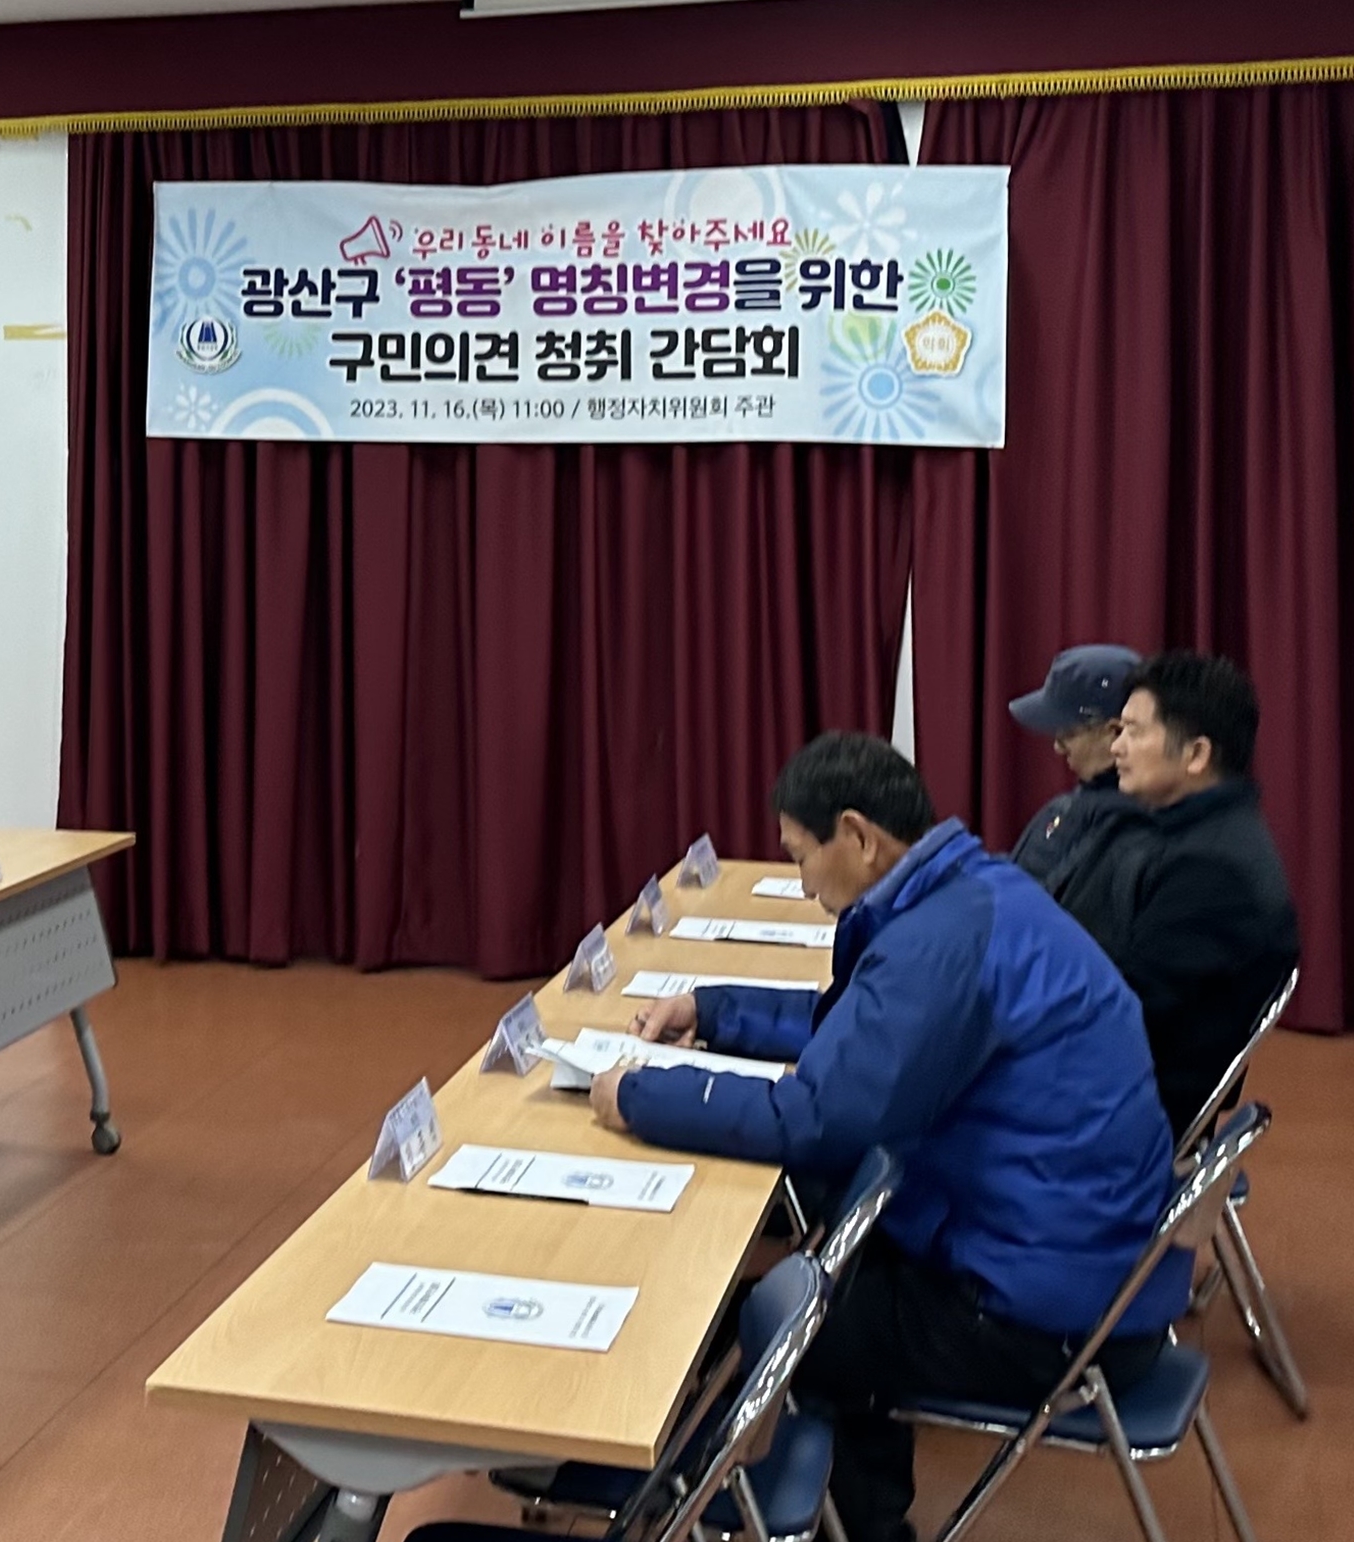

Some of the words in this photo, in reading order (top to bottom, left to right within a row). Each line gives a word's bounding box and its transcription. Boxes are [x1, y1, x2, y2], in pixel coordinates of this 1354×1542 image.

[540, 220, 625, 258] 이름을
[637, 216, 792, 256] 찾아주세요
[240, 265, 380, 318] 광산구
[530, 257, 784, 317] 명칭변경을
[797, 257, 904, 312] 위한
[329, 331, 520, 382] 구민의견
[535, 328, 632, 382] 청취
[649, 324, 801, 380] 간담회
[350, 400, 403, 418] 2023.
[413, 400, 436, 418] 11.
[514, 400, 566, 418] 11:00
[571, 398, 582, 420] /
[587, 396, 728, 419] 행정자치위원회
[734, 395, 776, 418] 주관
